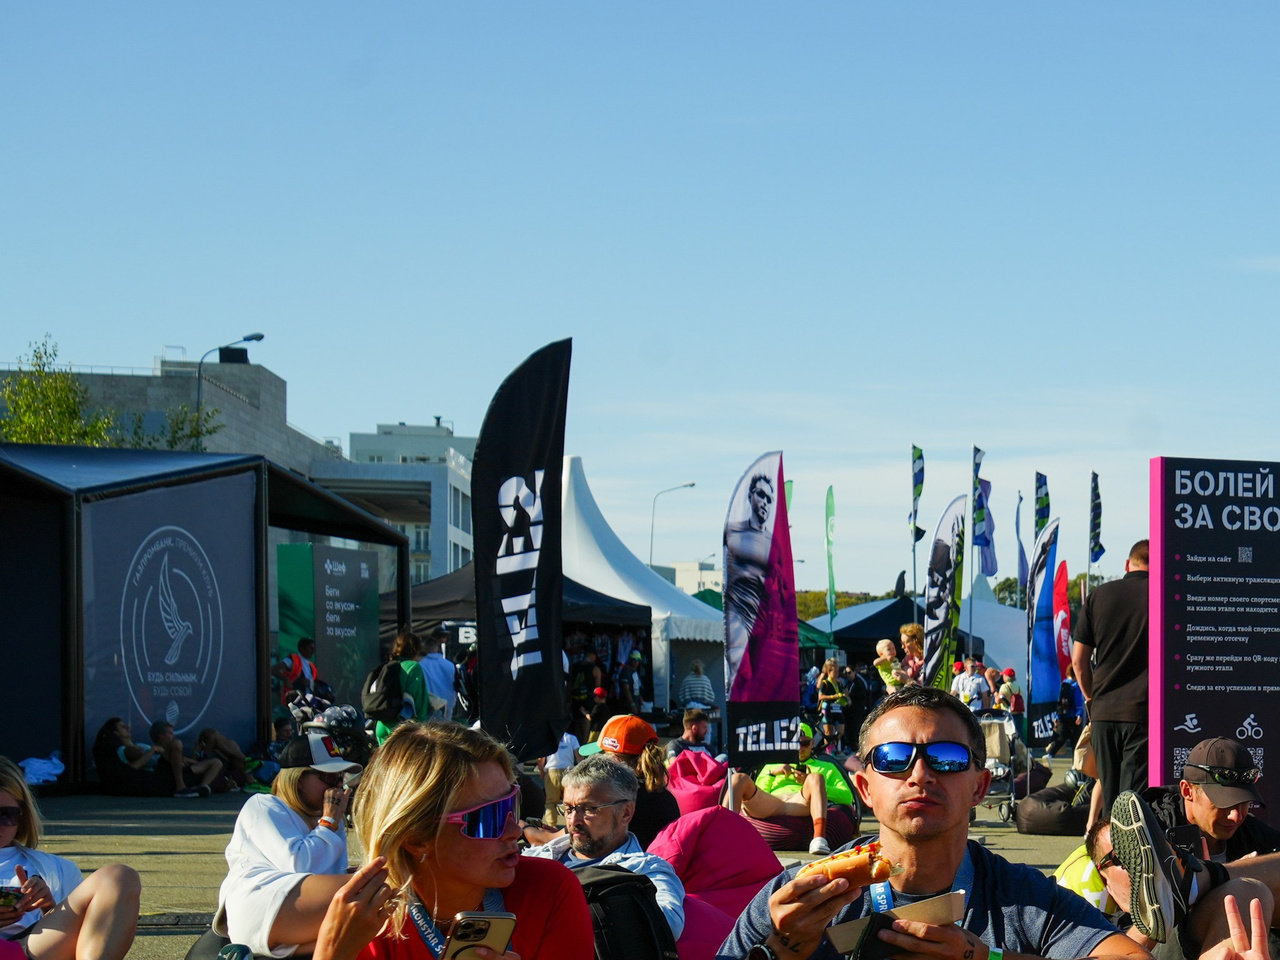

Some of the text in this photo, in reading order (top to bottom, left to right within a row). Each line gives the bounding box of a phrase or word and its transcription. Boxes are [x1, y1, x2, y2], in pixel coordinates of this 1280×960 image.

[1175, 467, 1274, 498] БОЛЕЙ
[1174, 503, 1214, 529] ЗА
[1186, 554, 1206, 563] Зайди
[1187, 574, 1211, 583] Выбери
[1213, 576, 1244, 584] активную
[1187, 594, 1206, 602] Введи
[1186, 624, 1216, 632] Дождись,
[1187, 635, 1223, 643] временную
[1186, 654, 1204, 662] Сразу
[1252, 655, 1278, 663] QR-коду
[1186, 684, 1205, 692] Следи
[736, 716, 801, 752] TELE2
